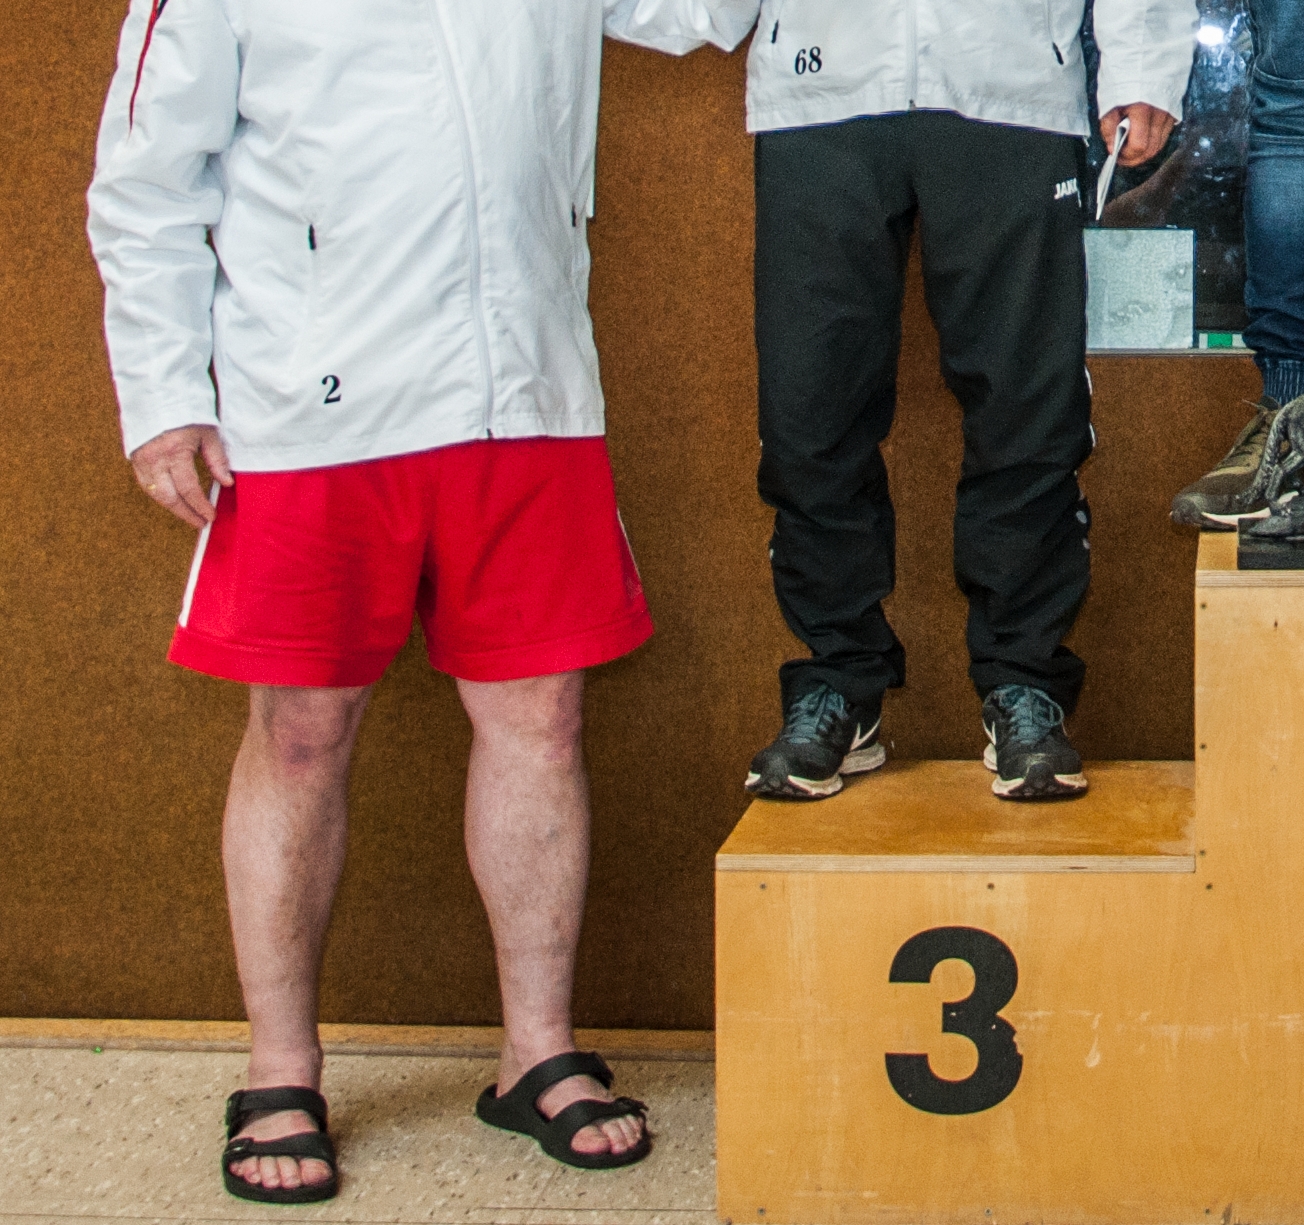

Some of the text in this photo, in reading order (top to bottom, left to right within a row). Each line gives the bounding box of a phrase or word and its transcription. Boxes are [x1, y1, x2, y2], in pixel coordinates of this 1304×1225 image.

[795, 47, 823, 75] 68
[1053, 177, 1079, 200] JAK
[322, 376, 342, 405] 2
[885, 926, 1024, 1117] 3
